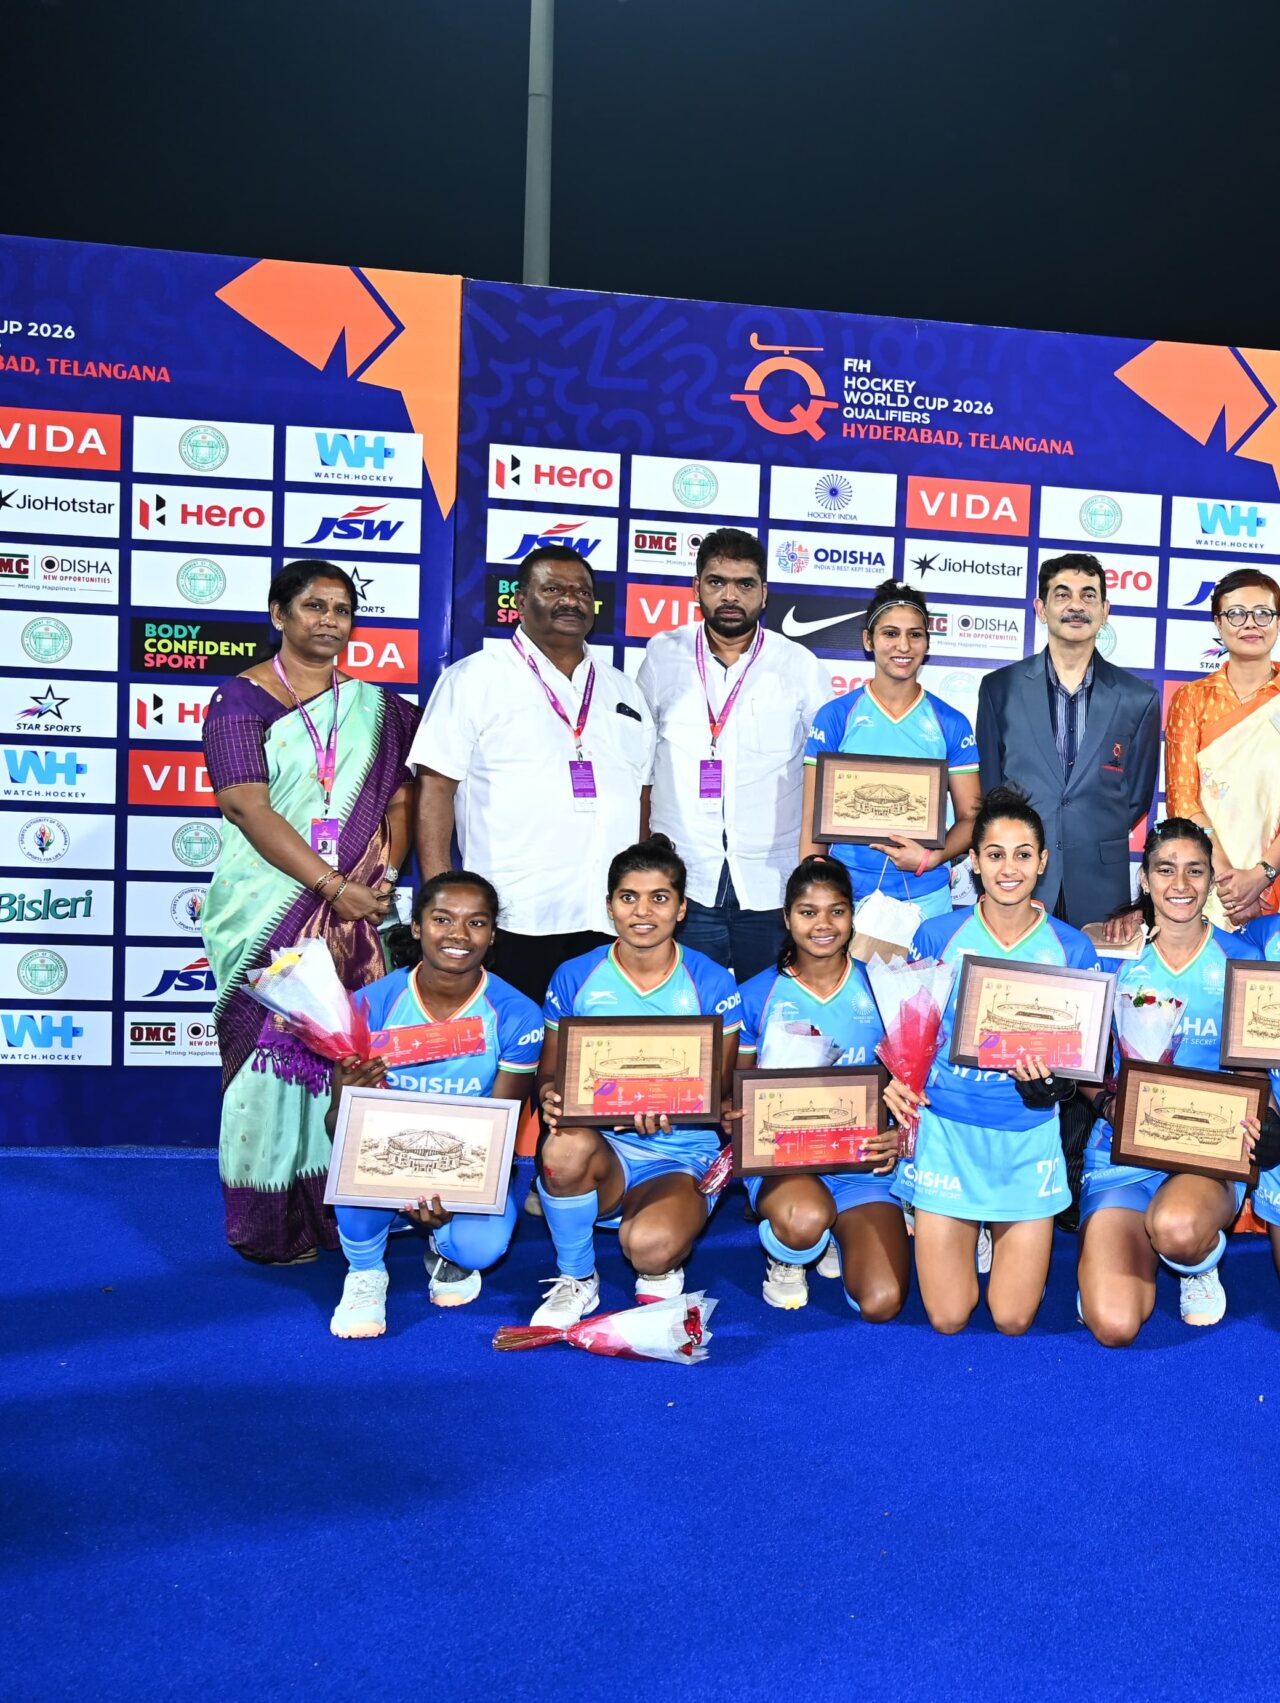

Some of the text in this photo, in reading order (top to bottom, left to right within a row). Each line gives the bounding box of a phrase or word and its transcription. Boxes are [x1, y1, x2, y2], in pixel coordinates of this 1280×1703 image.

[0, 320, 75, 339] UP 2026
[47, 358, 171, 383] TELANGANA
[843, 358, 871, 374] FIH
[844, 375, 916, 394] HOCKEY
[843, 390, 993, 415] WORLD CUP 2026
[842, 407, 931, 424] QUALIFIERS
[0, 422, 107, 455] VIDA
[842, 423, 1074, 456] HYDERABAD, TELANGANA
[314, 471, 394, 482] WATCH.HOCKEY
[534, 463, 613, 490] Hero
[16, 494, 115, 515] JioHotstar
[920, 490, 1018, 522] VIDA
[181, 503, 265, 529] Hero
[807, 511, 858, 521] HOCKEY INDIA
[300, 516, 404, 544] JSW
[634, 534, 677, 552] OMC
[1195, 539, 1264, 549] WATCH.HOCKEY
[814, 548, 886, 566] ODISHA
[0, 558, 29, 574] MC
[939, 558, 1023, 577] JioHotstar
[18, 583, 77, 593] Mining Happiness
[60, 575, 111, 584] OPPORTUNITIES
[1105, 569, 1152, 591] ero
[355, 605, 385, 614] PORTS
[145, 624, 200, 639] BODY
[974, 633, 1017, 641] OPPORTUNITIES
[144, 639, 257, 657] CONFIDENT
[144, 654, 208, 669] SPORT
[16, 722, 82, 732] STAR SPORTS
[143, 764, 214, 793] VID
[3, 789, 87, 798] WATCH.HOCKEY
[0, 889, 93, 922] Bisleri
[130, 1025, 176, 1042] OMC
[1191, 1038, 1217, 1046] SECRET
[1, 1053, 82, 1061] WATCH.HOCKEY
[165, 1050, 187, 1058] Mining
